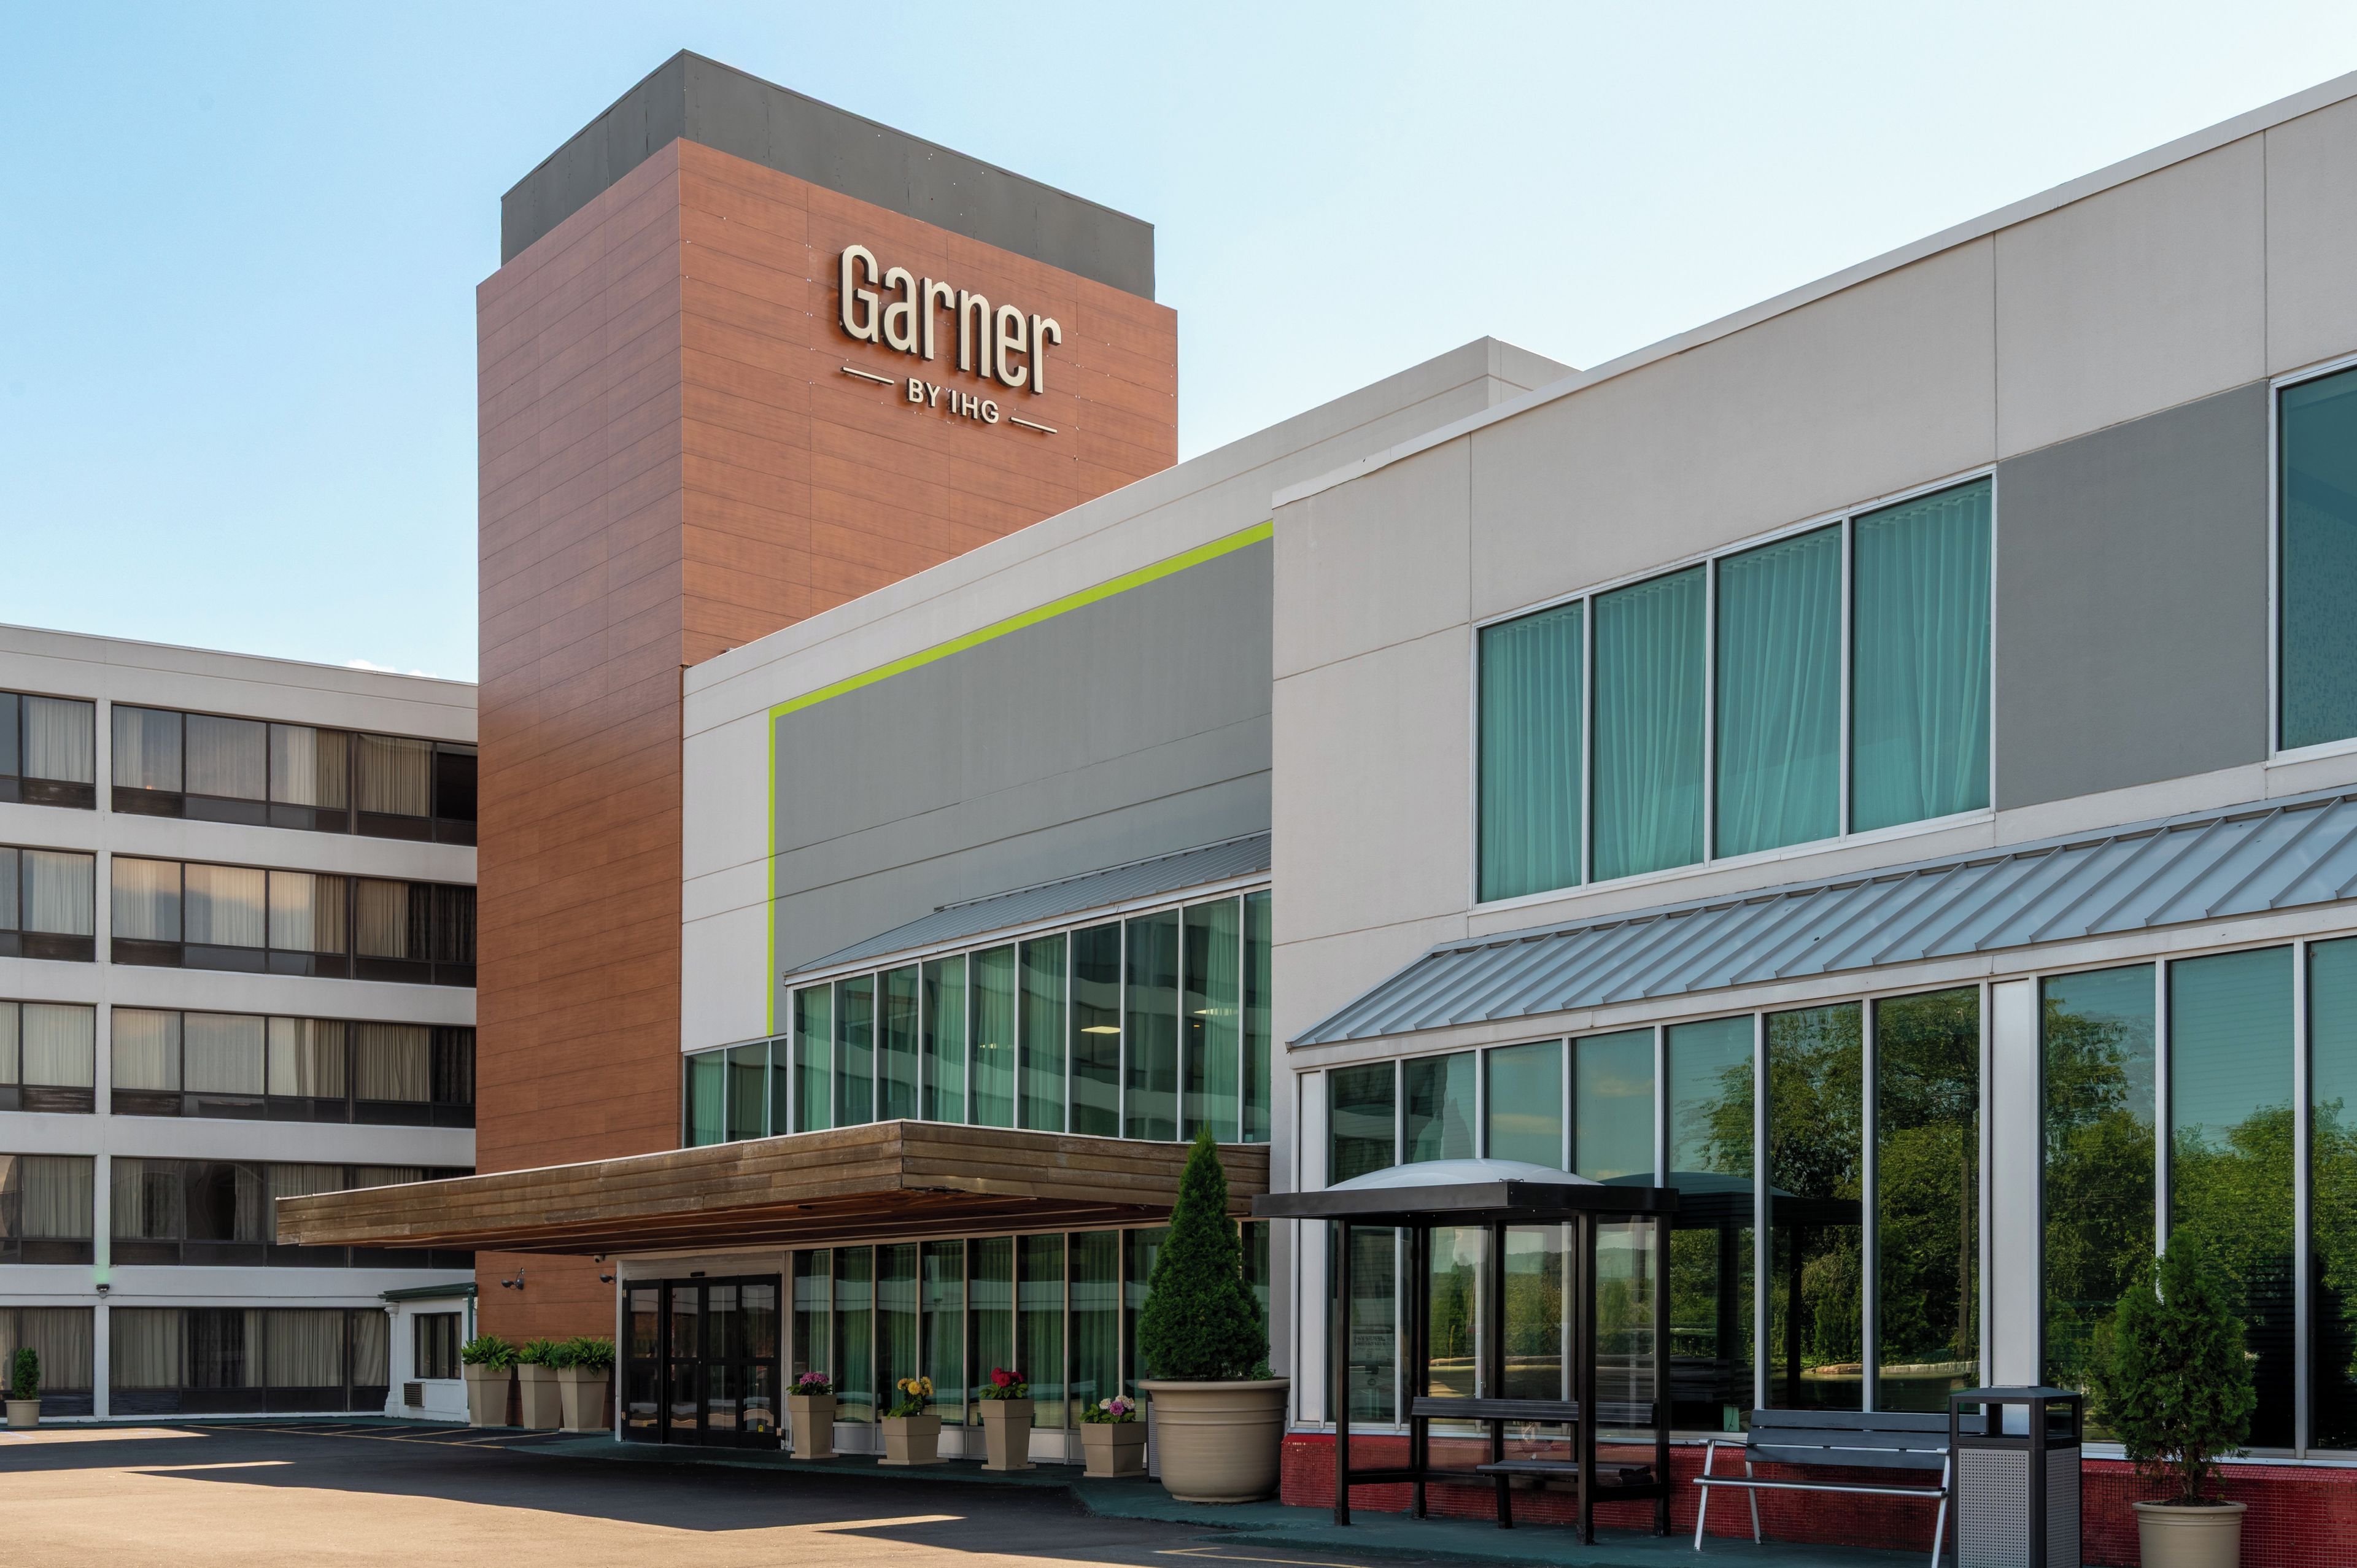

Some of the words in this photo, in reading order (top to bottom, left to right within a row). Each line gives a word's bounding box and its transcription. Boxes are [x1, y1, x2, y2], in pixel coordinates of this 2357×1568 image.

[838, 244, 1062, 395] Garner
[907, 377, 940, 407] BY
[950, 390, 999, 424] IHG
